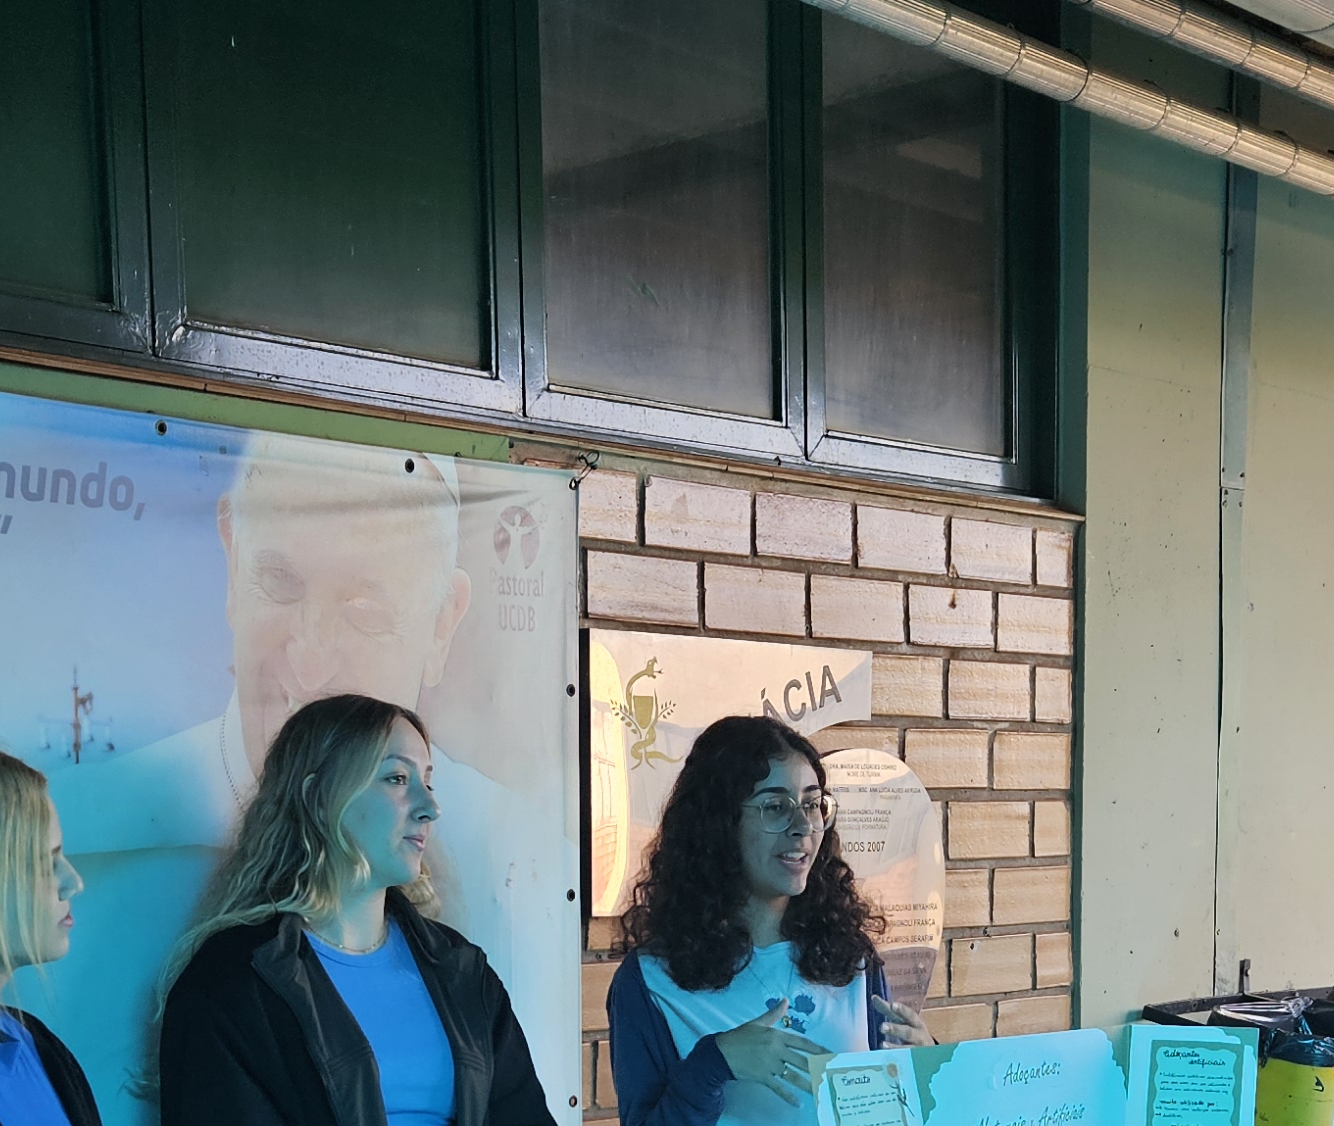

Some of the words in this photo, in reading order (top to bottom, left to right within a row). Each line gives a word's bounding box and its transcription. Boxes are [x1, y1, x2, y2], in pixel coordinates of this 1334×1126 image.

[489, 567, 544, 598] Pastoral
[498, 604, 536, 632] UCDB
[867, 841, 885, 852] 2007
[1003, 1060, 1061, 1086] Adoçantes:
